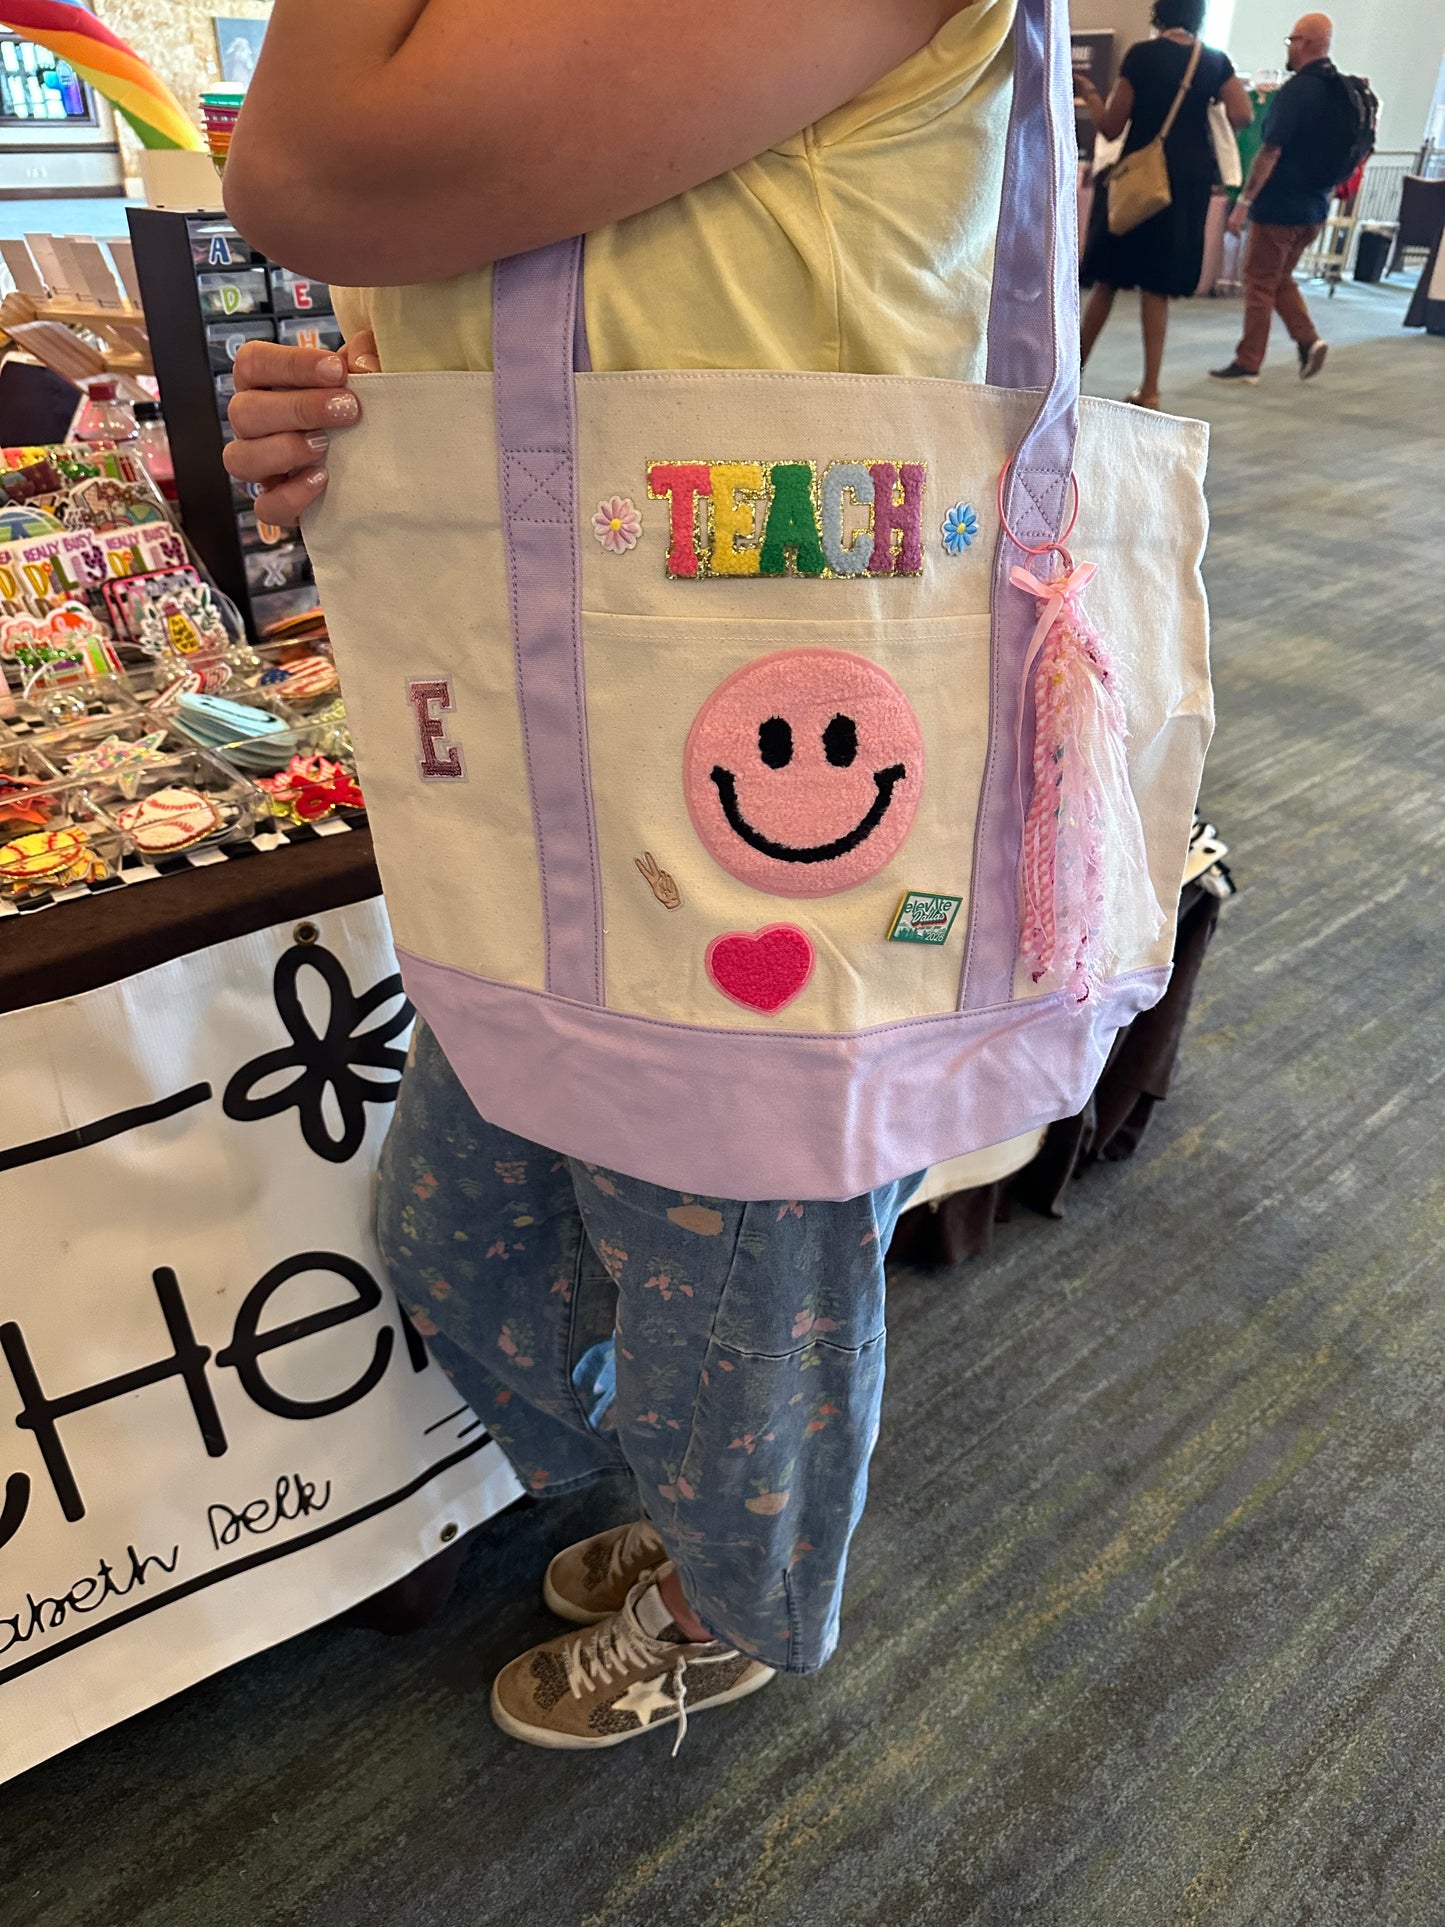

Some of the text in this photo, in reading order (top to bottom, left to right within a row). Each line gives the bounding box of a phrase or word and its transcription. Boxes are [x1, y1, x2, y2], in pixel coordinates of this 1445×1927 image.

[209, 235, 231, 265] A
[220, 285, 241, 315] D
[294, 281, 313, 309] E
[647, 461, 927, 578] TEACH
[263, 561, 287, 587] X
[409, 680, 463, 777] E
[911, 909, 947, 924] Dallas
[207, 1473, 331, 1551] Delk
